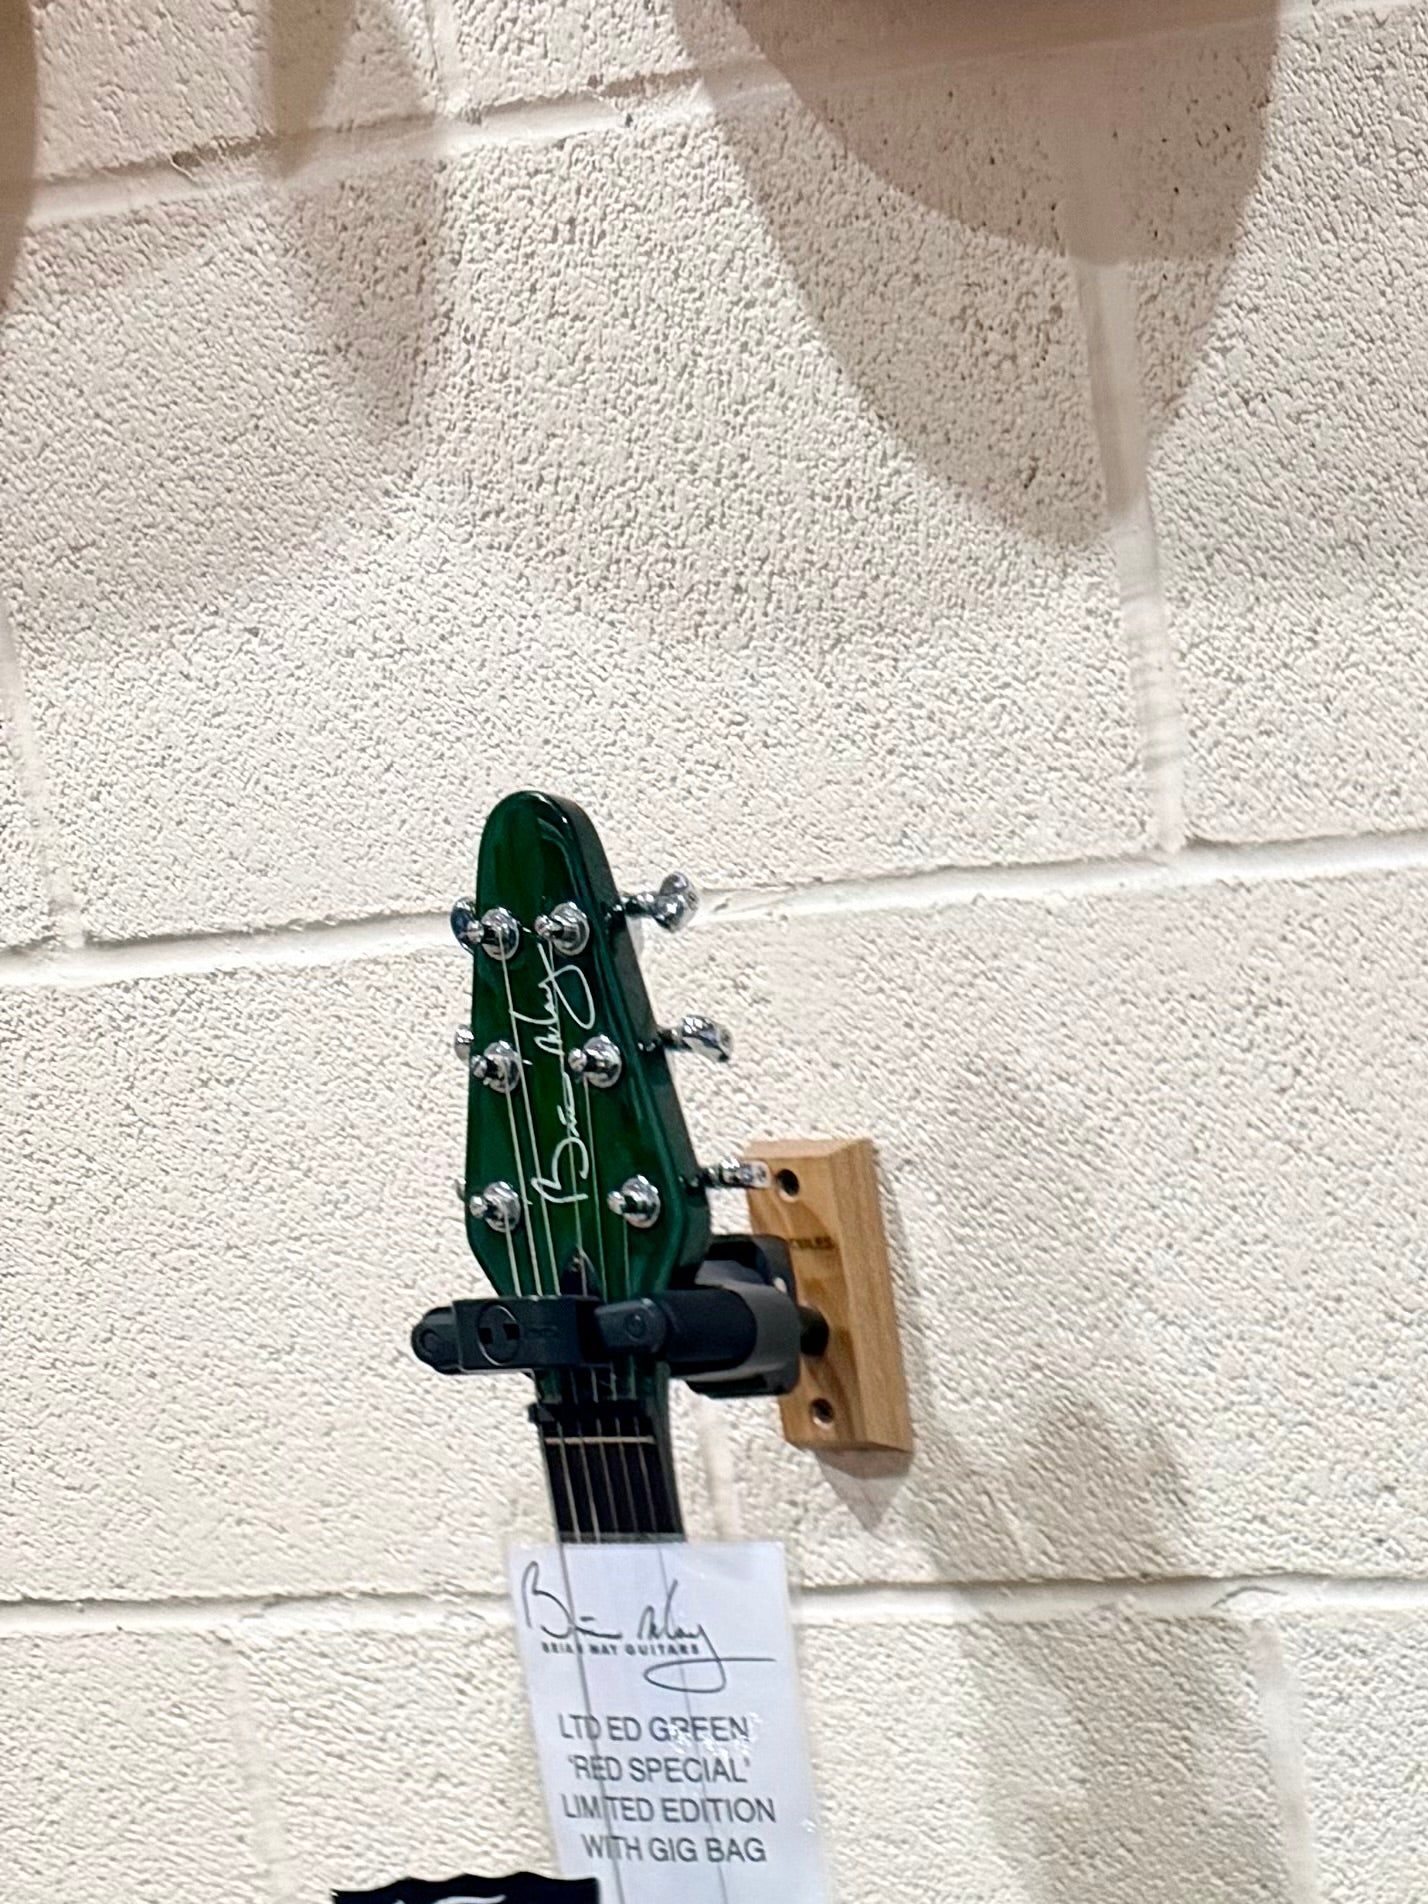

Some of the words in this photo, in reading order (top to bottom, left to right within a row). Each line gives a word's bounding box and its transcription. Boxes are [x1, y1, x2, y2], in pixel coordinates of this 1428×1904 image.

[558, 1713, 601, 1740] LTD
[606, 1715, 642, 1741] ED
[648, 1715, 750, 1742] GREEN
[561, 1793, 654, 1822] LIMTED
[661, 1797, 777, 1823] EDITION
[581, 1833, 643, 1862] WITH
[649, 1836, 699, 1863] GIG
[704, 1837, 768, 1863] BAG
